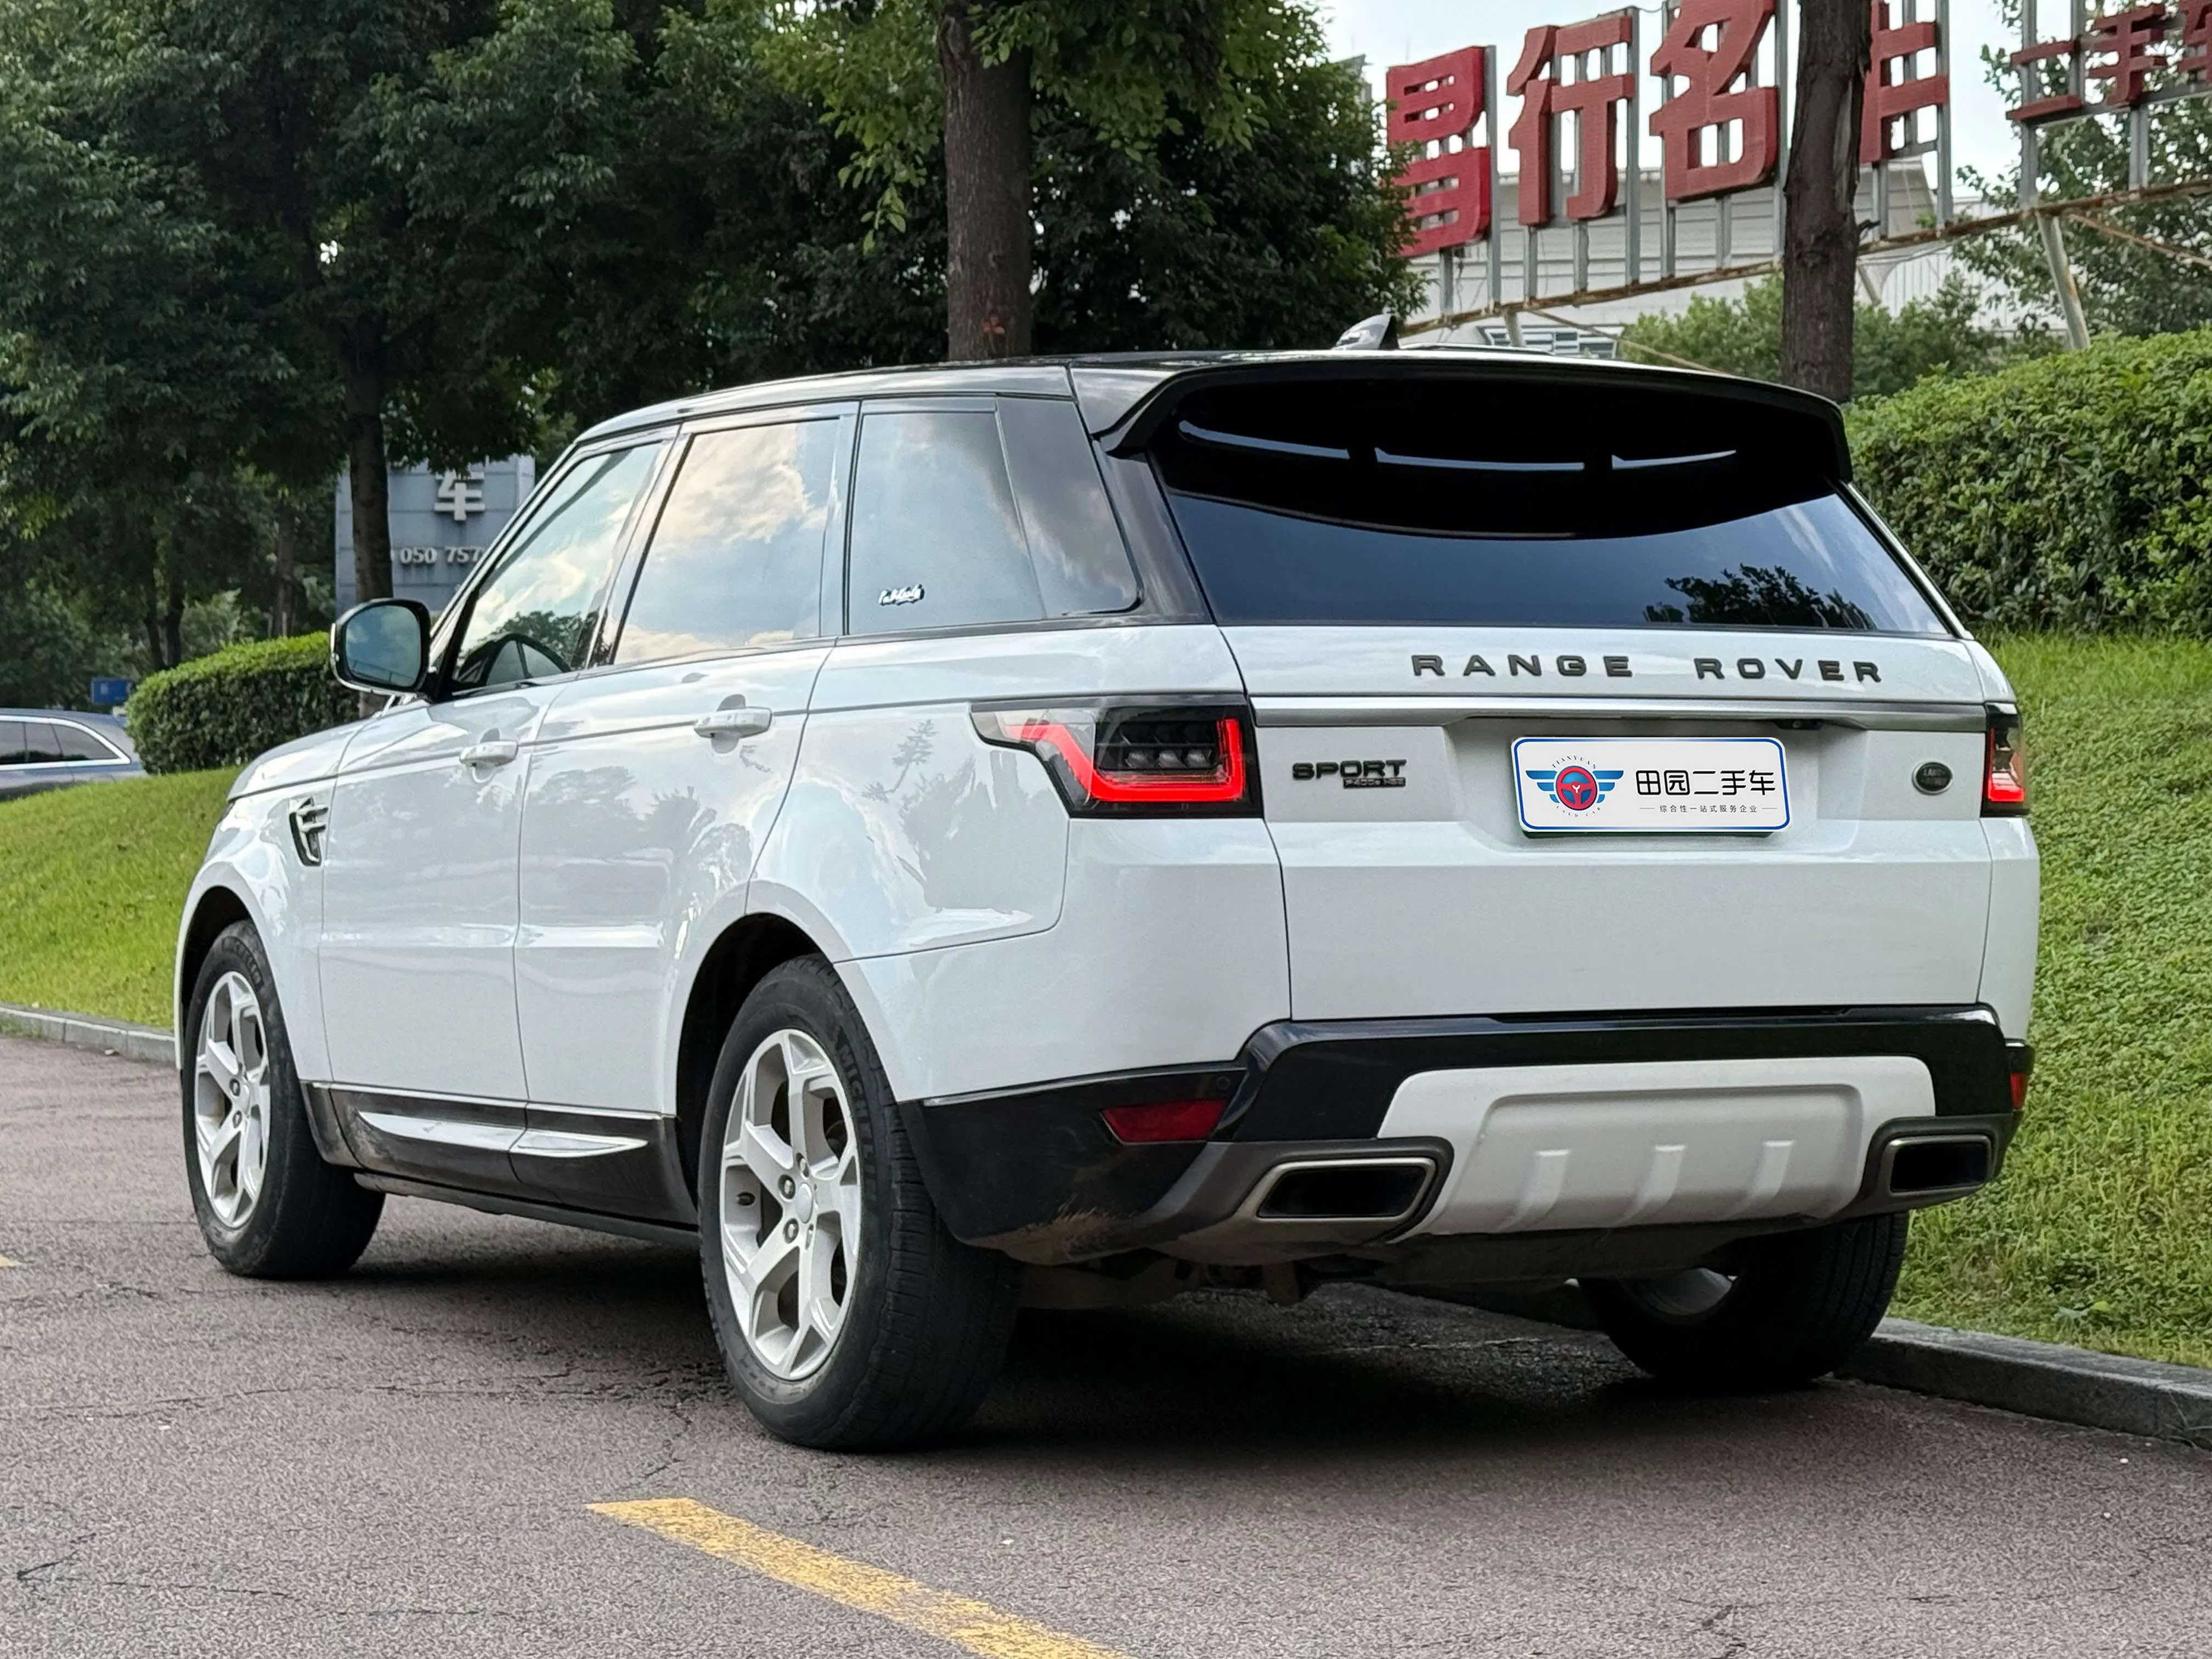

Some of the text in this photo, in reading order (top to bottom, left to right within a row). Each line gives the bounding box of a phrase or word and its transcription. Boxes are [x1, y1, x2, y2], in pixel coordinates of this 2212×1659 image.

[434, 466, 486, 521] 车
[400, 548, 437, 564] 050
[1412, 654, 1882, 682] RANGE ROVER
[1293, 759, 1408, 780] SPORT
